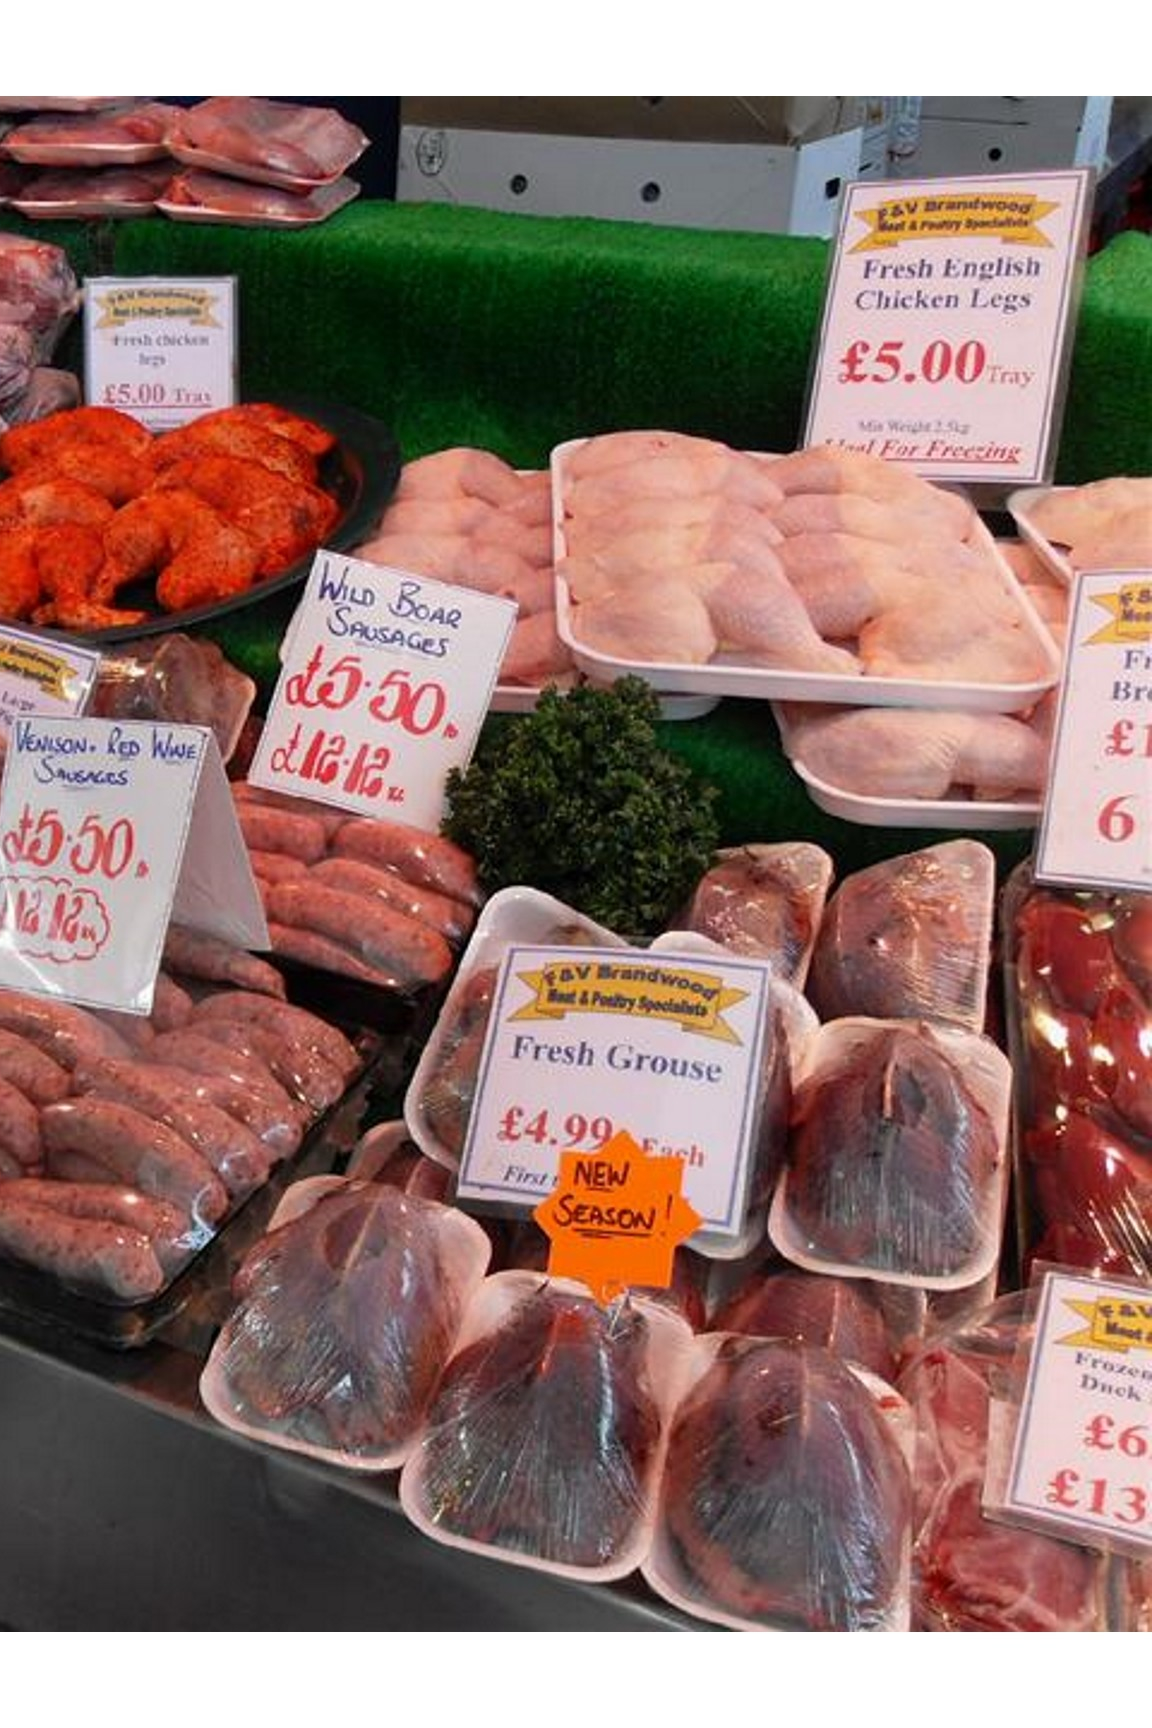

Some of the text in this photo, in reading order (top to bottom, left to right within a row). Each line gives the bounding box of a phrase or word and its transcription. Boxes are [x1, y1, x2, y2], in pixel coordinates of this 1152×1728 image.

[923, 196, 1033, 215] Brandwood
[919, 219, 960, 232] Poultry
[964, 217, 1030, 231] Specialists
[862, 257, 1041, 282] Fresh English
[854, 288, 1032, 316] Chicken Legs
[114, 333, 210, 347] Fresh chicken
[837, 339, 1035, 390] £5.00 Tray
[103, 383, 212, 404] £5.00 Tray
[887, 420, 930, 435] Weight
[880, 440, 919, 458] For
[925, 440, 1023, 464] Freezing
[1097, 793, 1137, 843] 6
[597, 963, 720, 1001] Brandwood
[547, 988, 577, 1005] Meat
[592, 989, 638, 1012] Poultry
[638, 995, 709, 1018] Specialists
[511, 1034, 723, 1084] Fresh Grouse
[496, 1104, 614, 1151] £4.99
[503, 1166, 551, 1187] First
[573, 1160, 631, 1188] NEW
[1080, 1373, 1142, 1403] Duck
